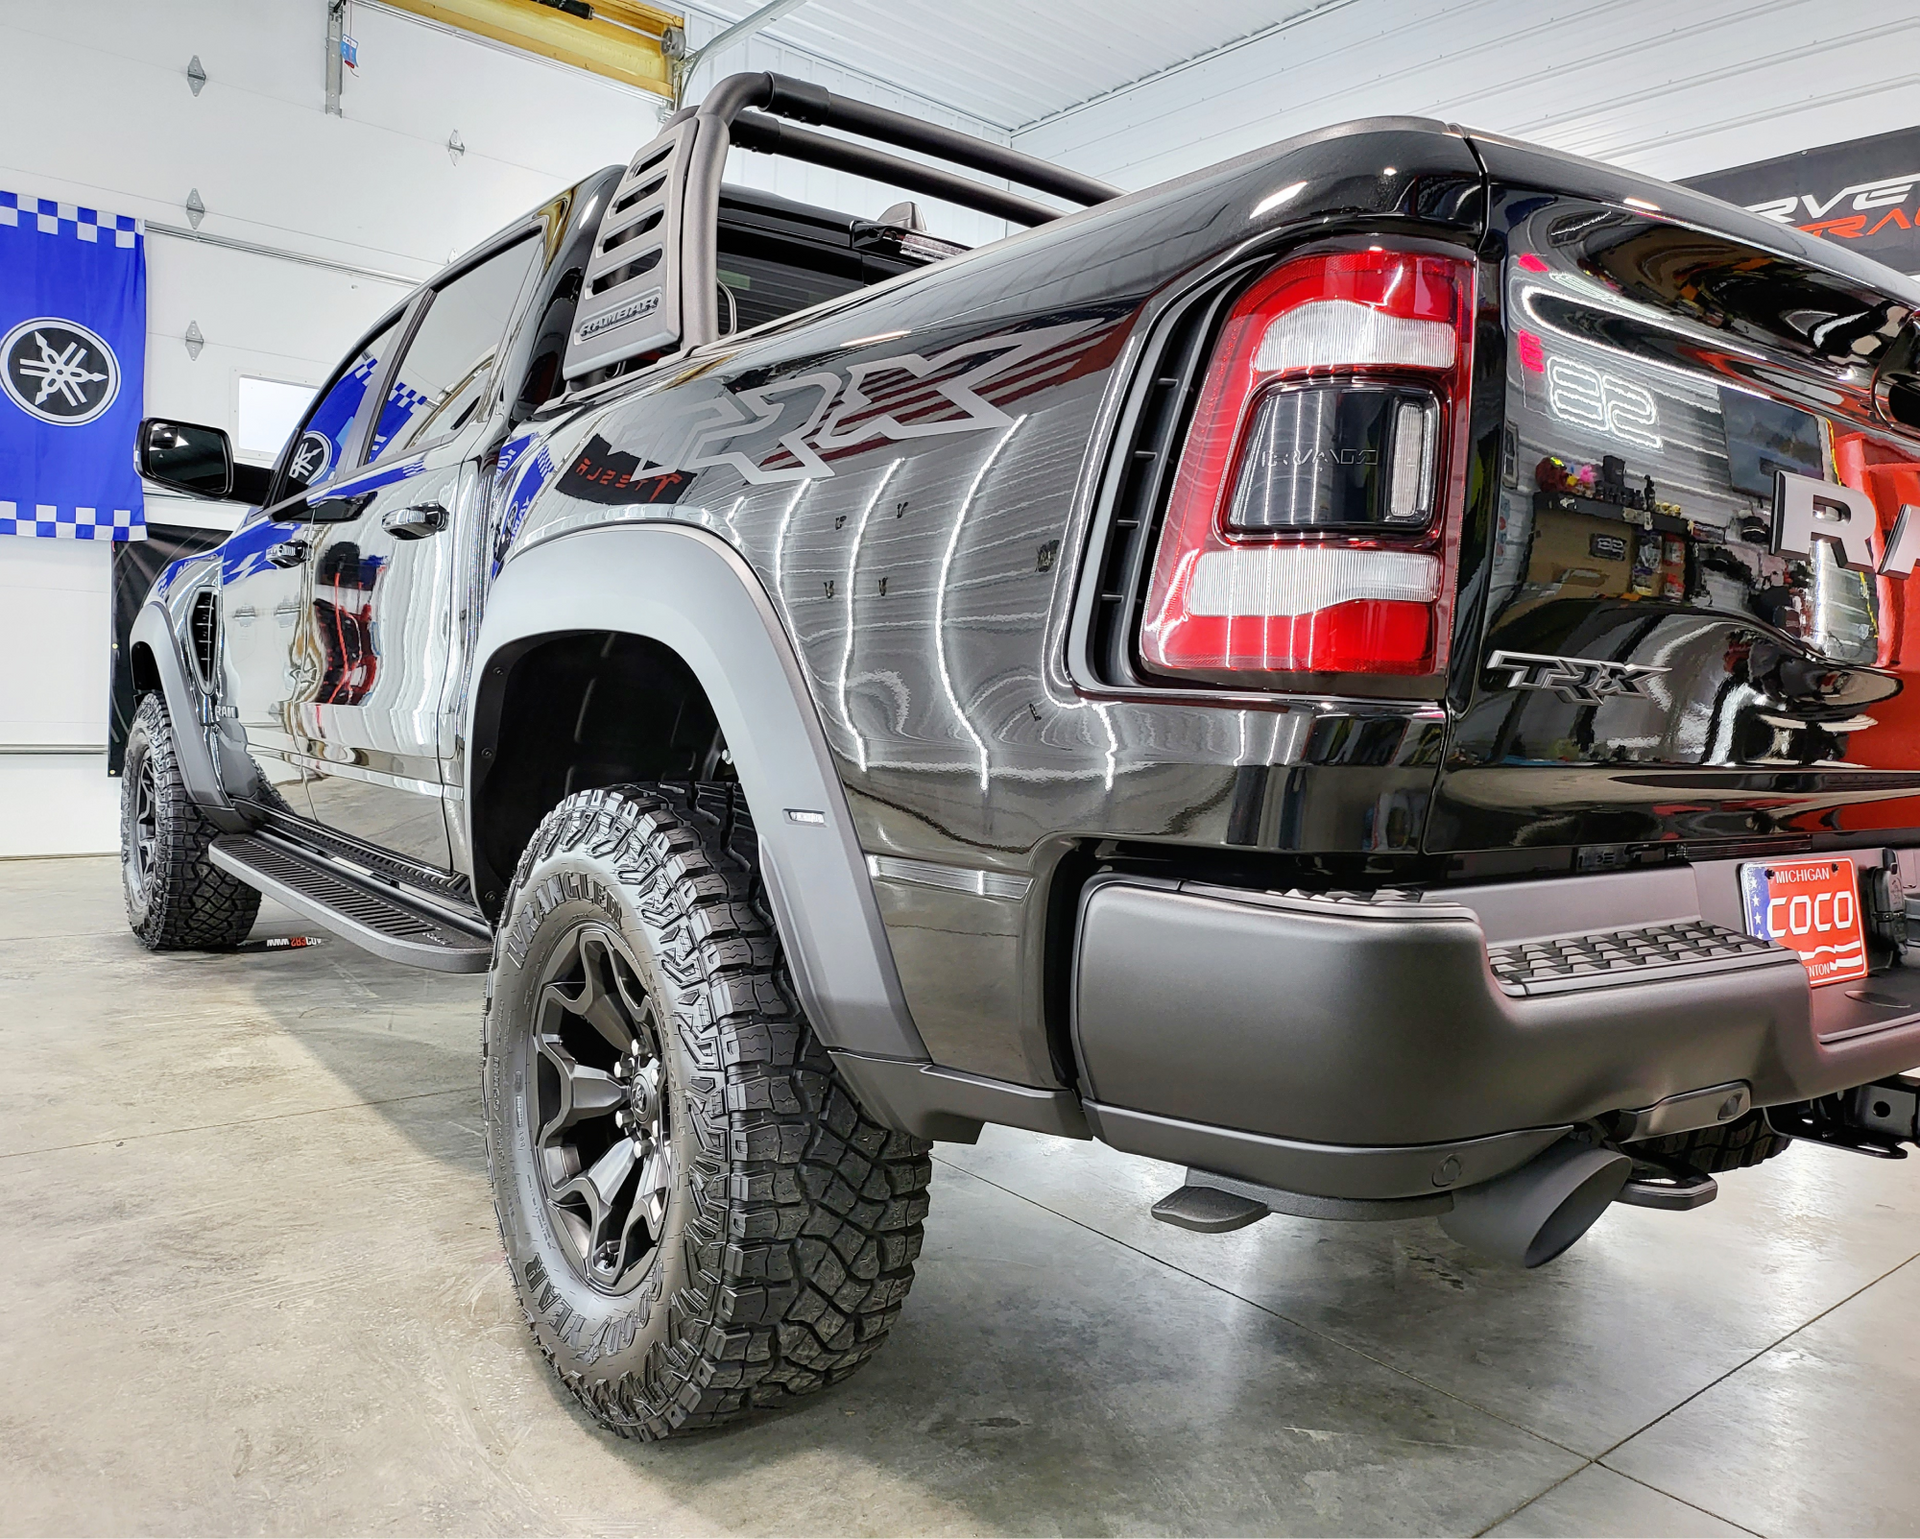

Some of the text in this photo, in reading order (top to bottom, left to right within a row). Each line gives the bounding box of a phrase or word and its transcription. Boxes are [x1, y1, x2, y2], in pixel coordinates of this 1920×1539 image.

[1486, 649, 1673, 706] TRX
[214, 705, 237, 719] RAM
[1775, 867, 1830, 884] MICHIGAN
[507, 870, 623, 970] WRANGLER
[1766, 890, 1853, 938] COCO
